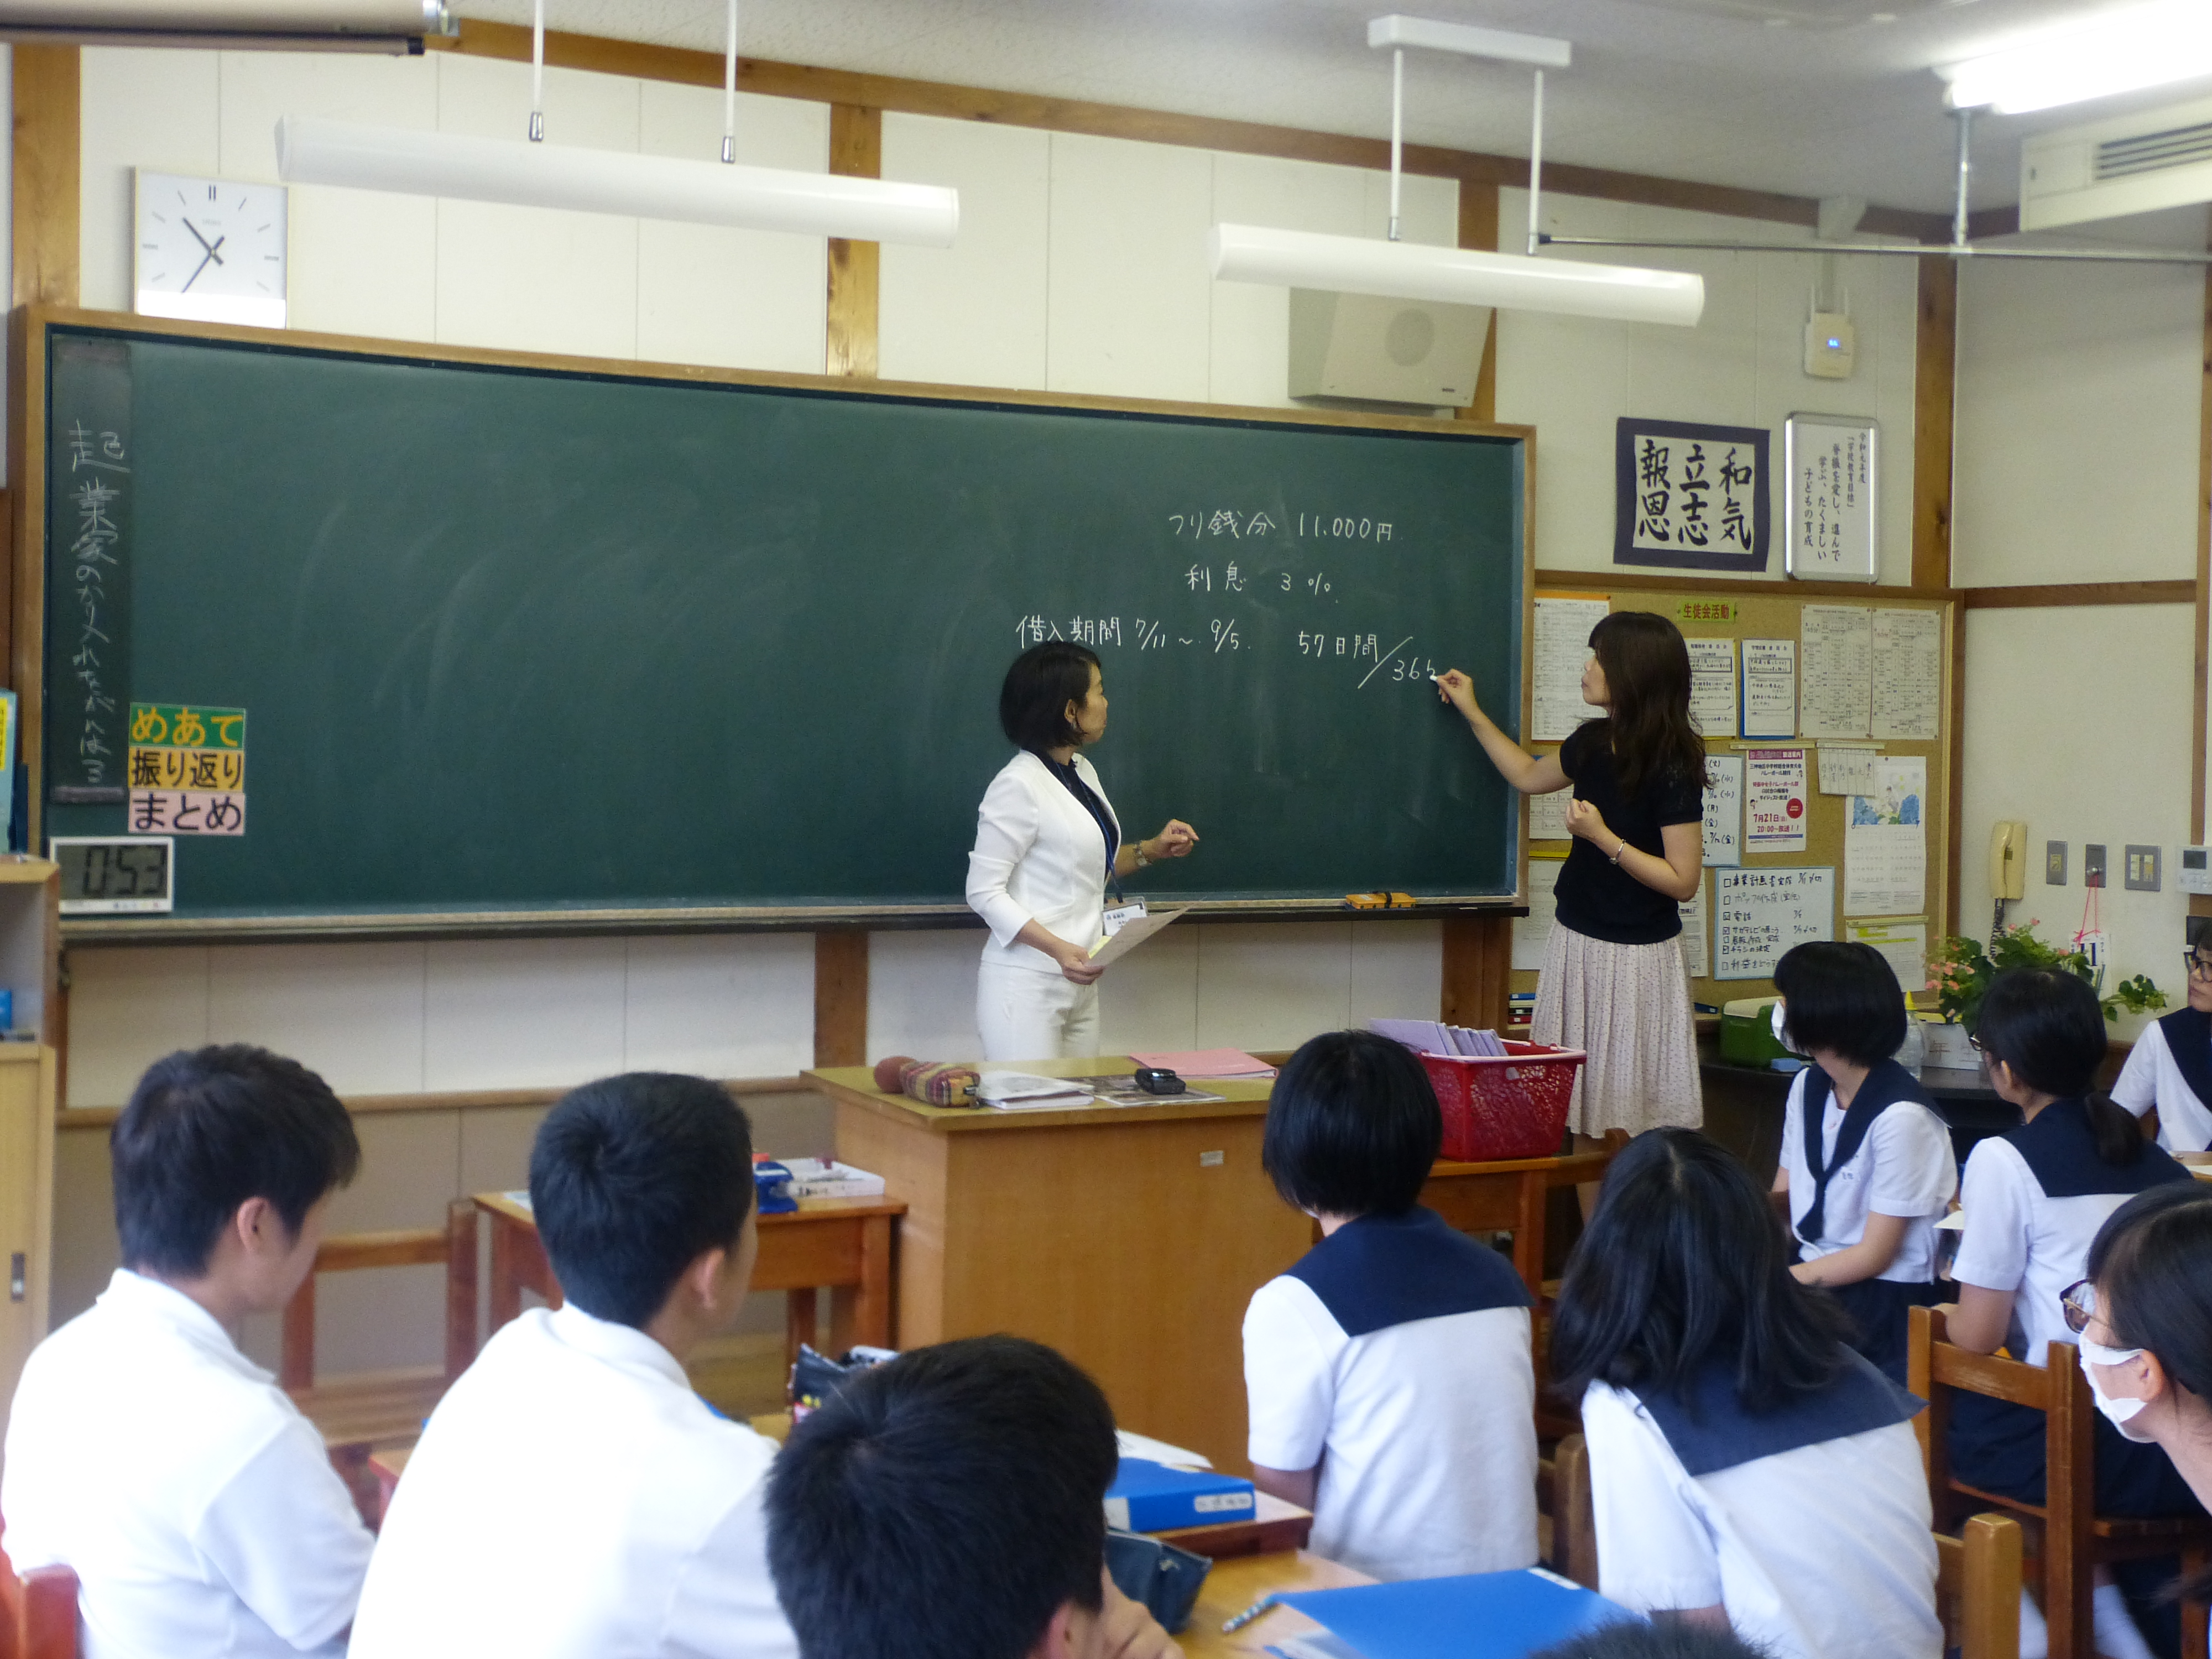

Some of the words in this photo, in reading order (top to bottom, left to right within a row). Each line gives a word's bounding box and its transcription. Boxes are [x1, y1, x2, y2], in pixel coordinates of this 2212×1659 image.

[1639, 439, 1671, 541] 報恩
[1678, 443, 1710, 546] 立志
[1718, 446, 1752, 551] 和気
[1803, 467, 1813, 547] 子どもの育成
[1185, 561, 1246, 592] 利息
[1015, 614, 1121, 649] 借入期間
[1683, 603, 1729, 619] 生徒会活動
[132, 706, 243, 747] めあて
[132, 748, 241, 789] 振り返り
[133, 791, 242, 831] まとめ
[1734, 911, 1751, 922] 電話
